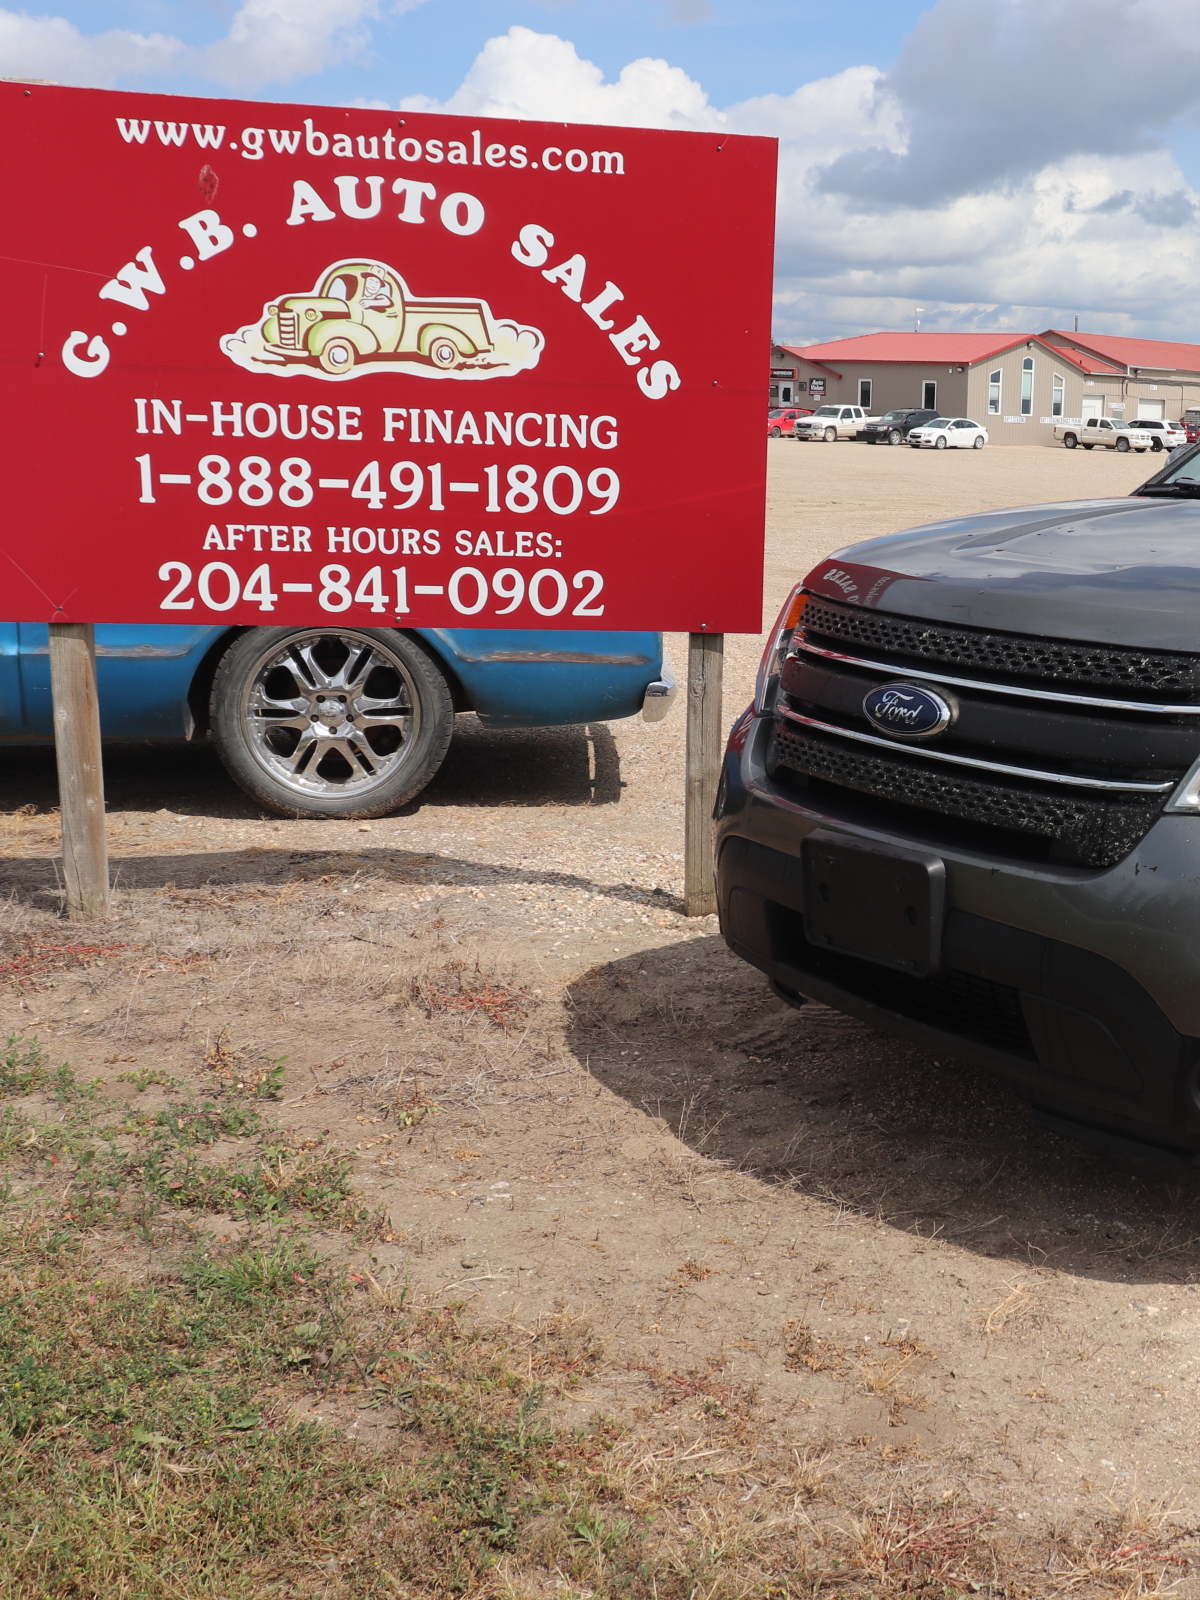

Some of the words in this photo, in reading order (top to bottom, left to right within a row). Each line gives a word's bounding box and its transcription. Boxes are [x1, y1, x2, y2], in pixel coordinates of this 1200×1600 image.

[115, 117, 625, 175] www.gwbautosales.com
[61, 209, 258, 379] G.W.B.
[285, 175, 486, 236] AUTO
[510, 223, 682, 400] SALES
[134, 398, 363, 441] IN-HOUSE
[382, 407, 618, 450] FINANCING
[134, 453, 620, 516] 1-888-491-1809
[202, 523, 313, 553] AFTER
[326, 526, 441, 555] HOURS
[454, 529, 564, 558] SALES:
[158, 560, 605, 617] 204-841-0902
[874, 690, 924, 725] Ford
